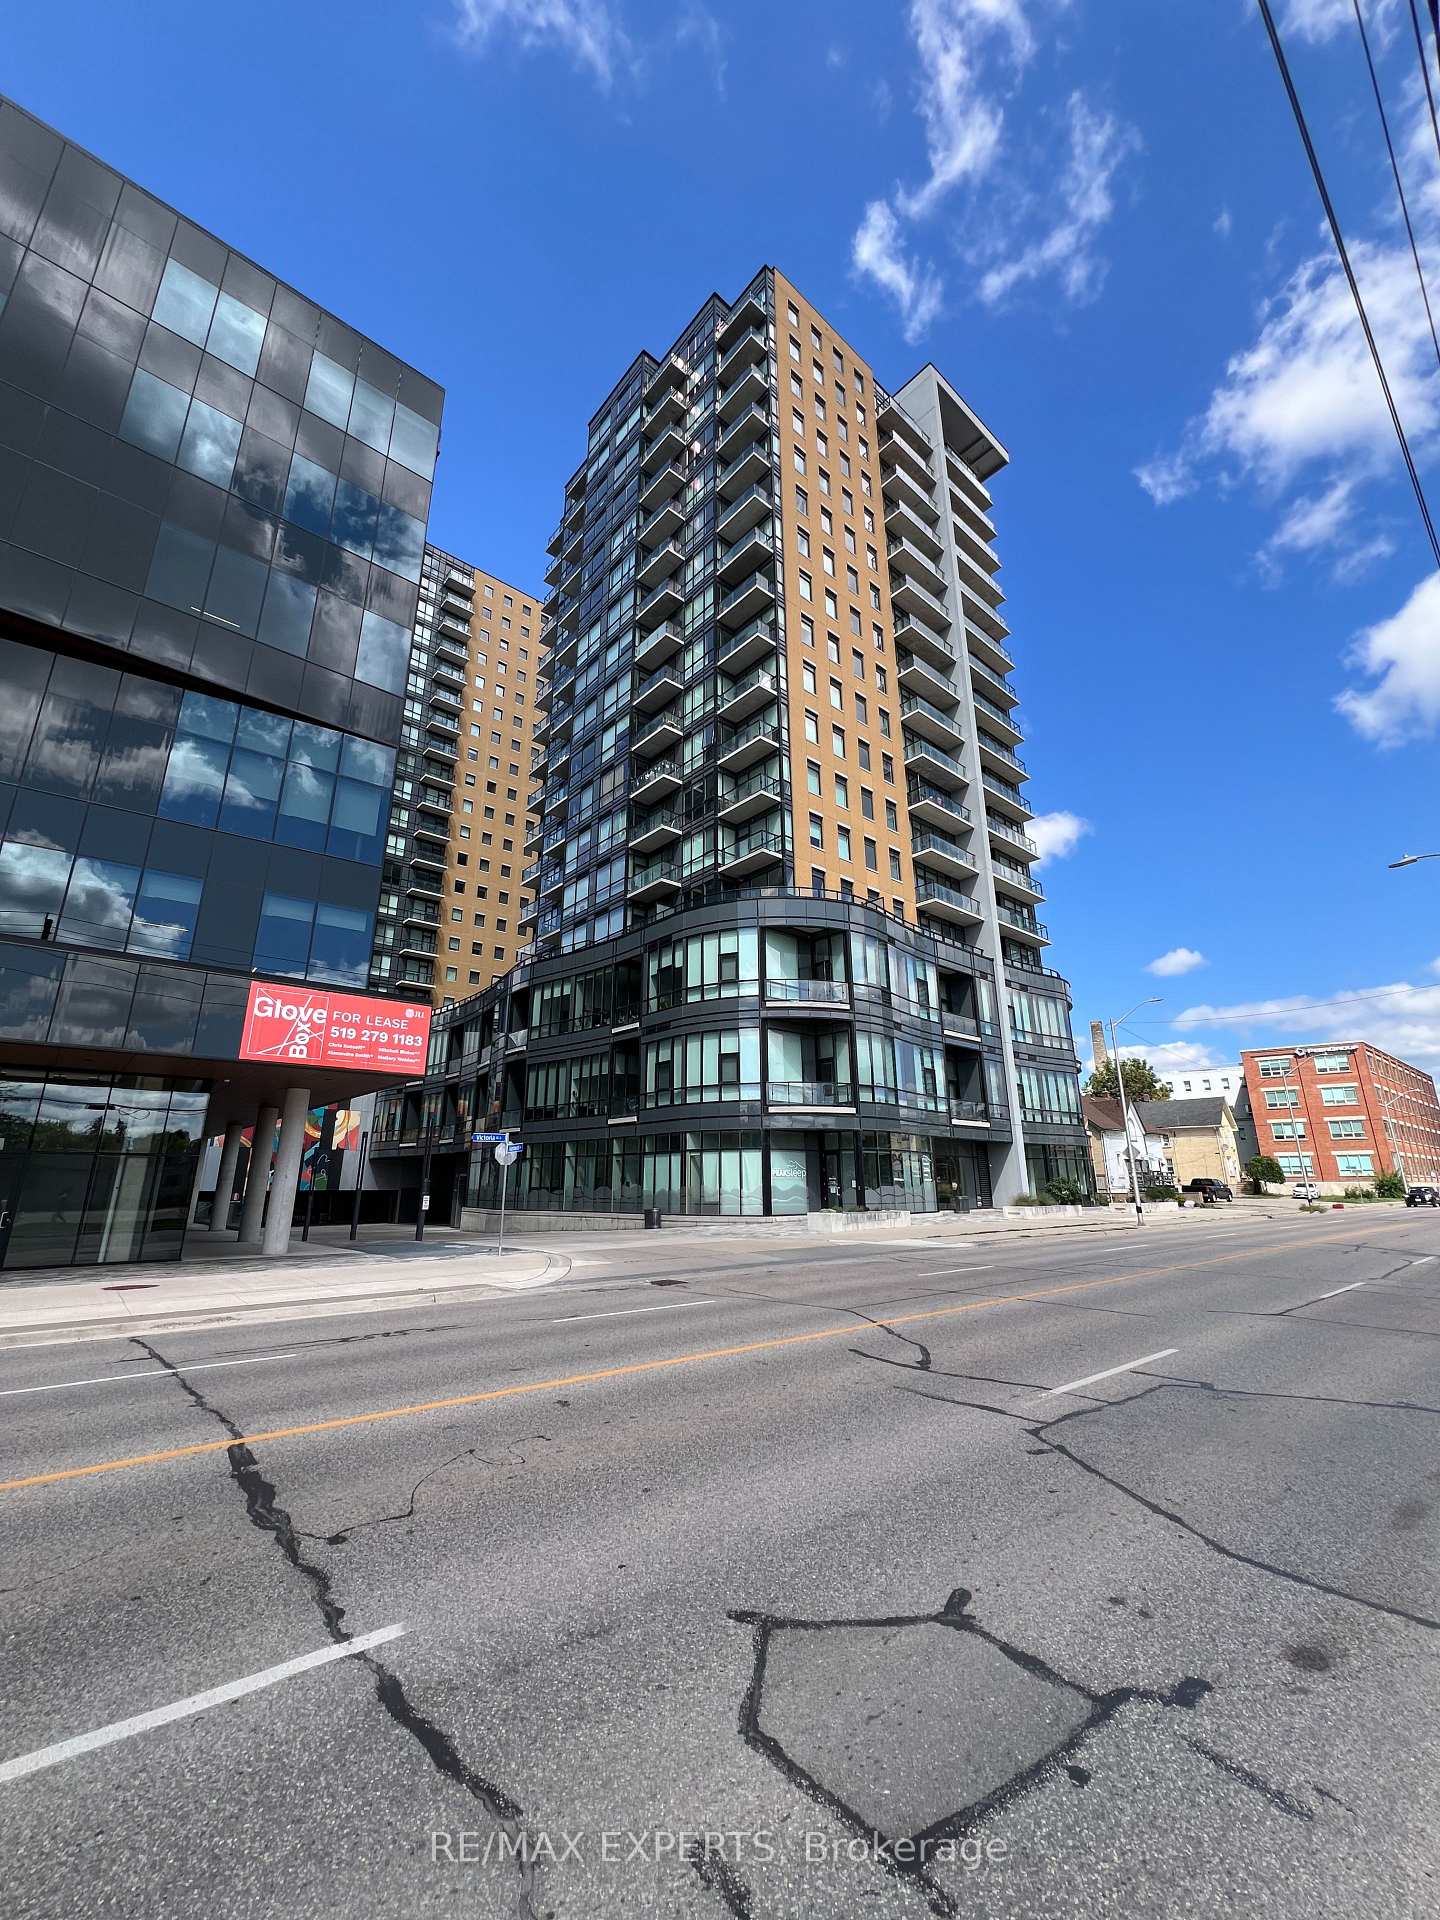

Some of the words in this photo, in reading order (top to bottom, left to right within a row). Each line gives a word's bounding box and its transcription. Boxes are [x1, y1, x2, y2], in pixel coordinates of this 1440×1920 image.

[254, 996, 327, 1024] Glove
[333, 1010, 361, 1025] FOR
[366, 1013, 409, 1030] LEASE
[288, 1020, 312, 1059] Box
[330, 1025, 357, 1040] 519
[361, 1029, 389, 1043] 279
[392, 1033, 423, 1047] 1183
